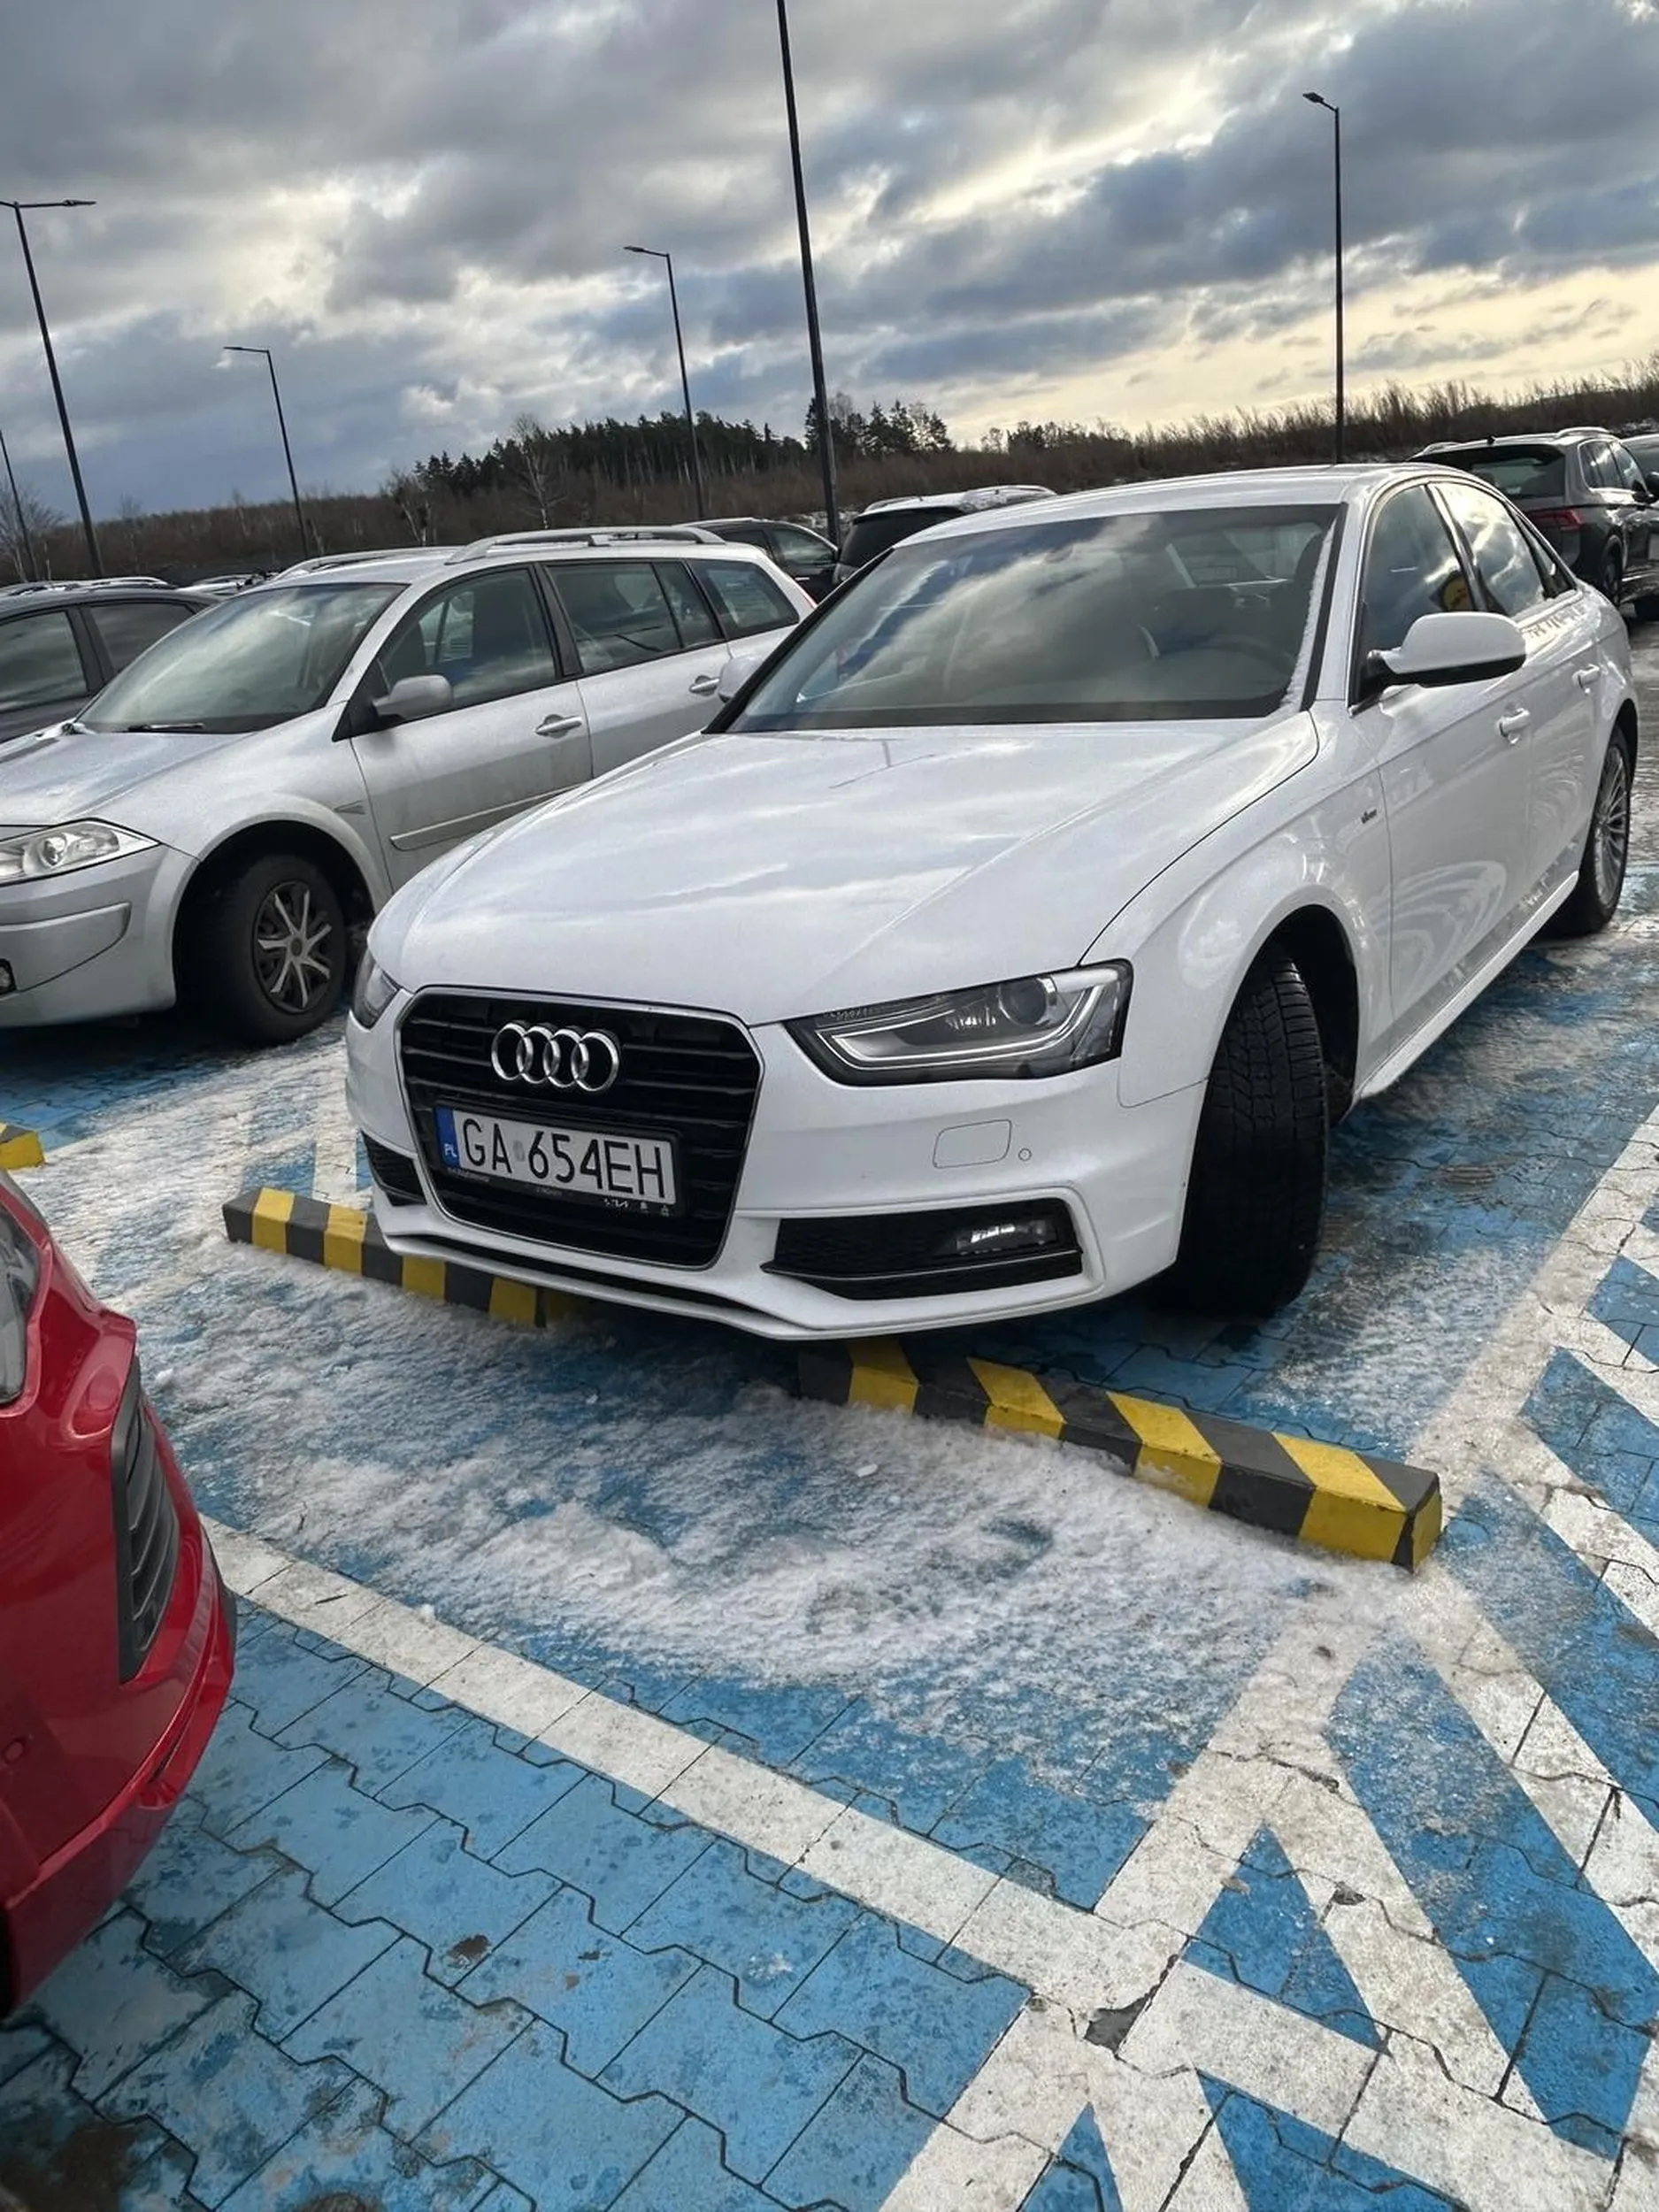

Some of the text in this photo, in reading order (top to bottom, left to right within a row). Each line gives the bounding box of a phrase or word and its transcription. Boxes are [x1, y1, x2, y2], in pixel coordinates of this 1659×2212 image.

[444, 1143, 457, 1157] PL
[463, 1118, 665, 1198] GA 654EH
